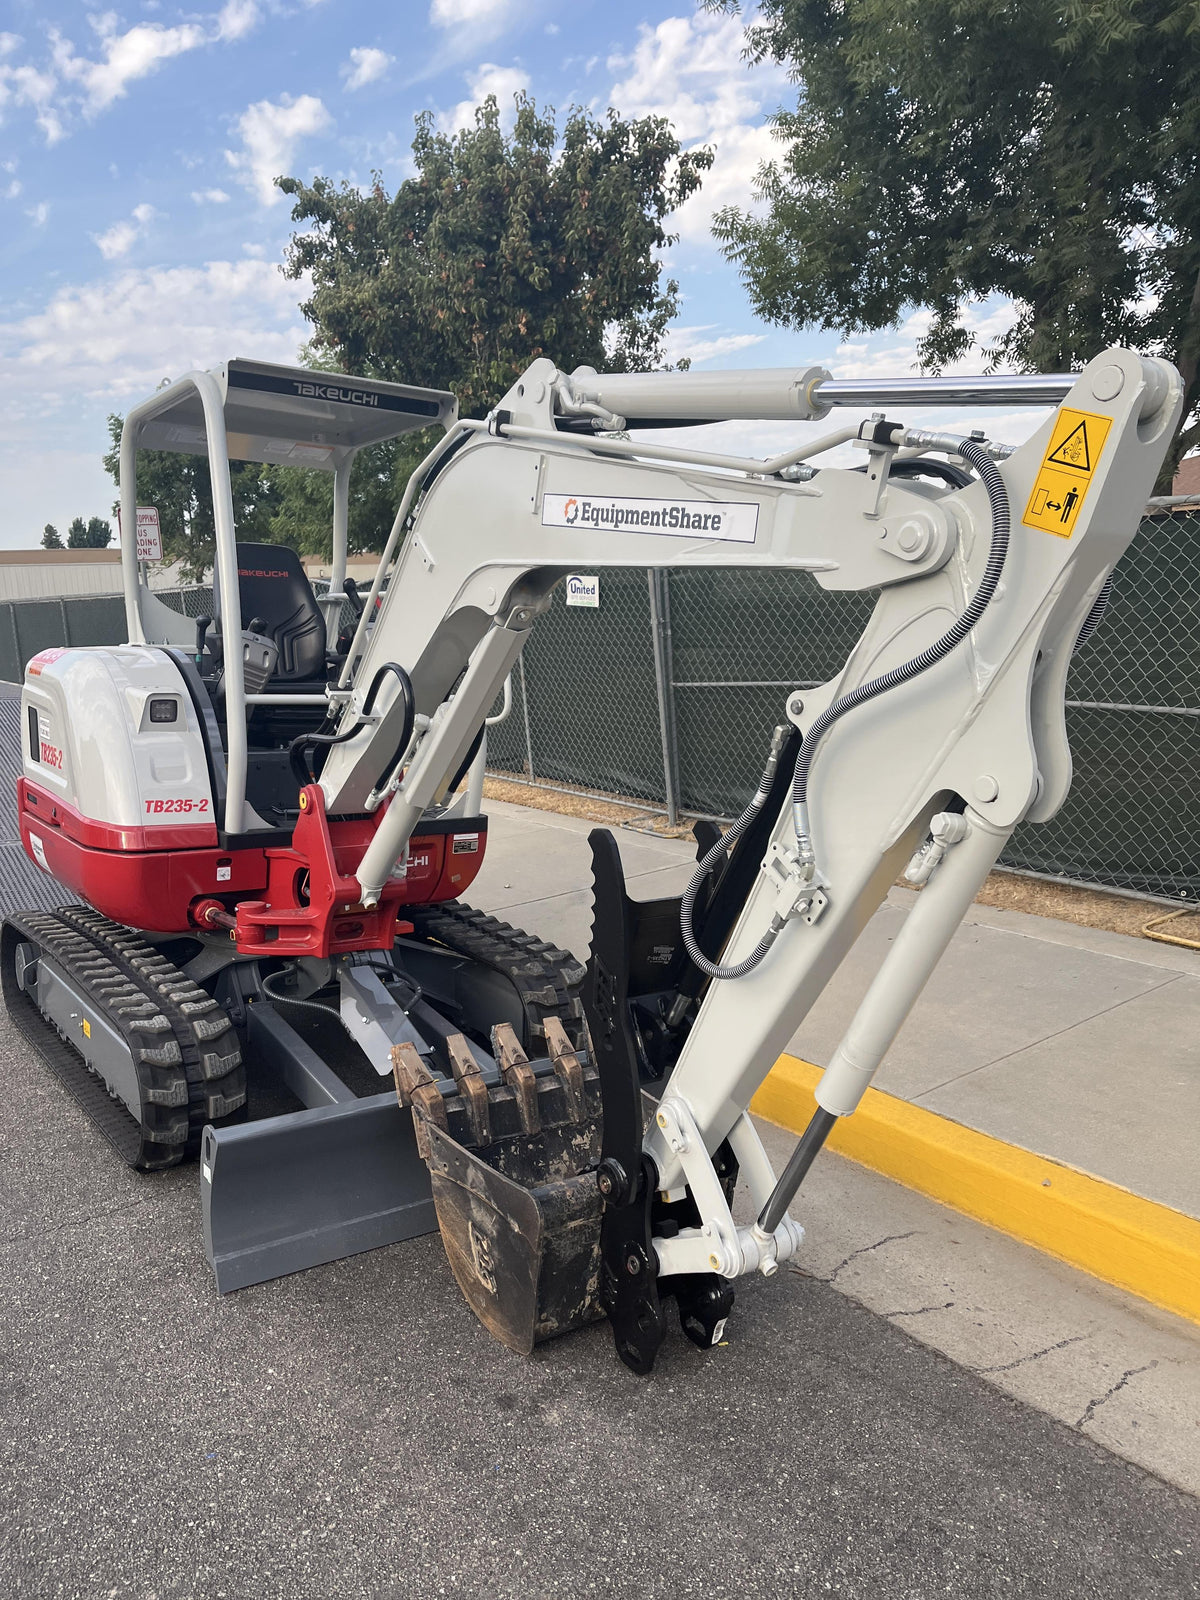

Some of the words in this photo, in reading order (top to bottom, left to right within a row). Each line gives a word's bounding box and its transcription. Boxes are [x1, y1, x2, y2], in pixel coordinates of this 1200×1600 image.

[581, 502, 722, 531] EquipmentShare
[570, 583, 596, 595] United
[40, 742, 63, 769] TB235-2
[145, 799, 209, 813] TB235-2
